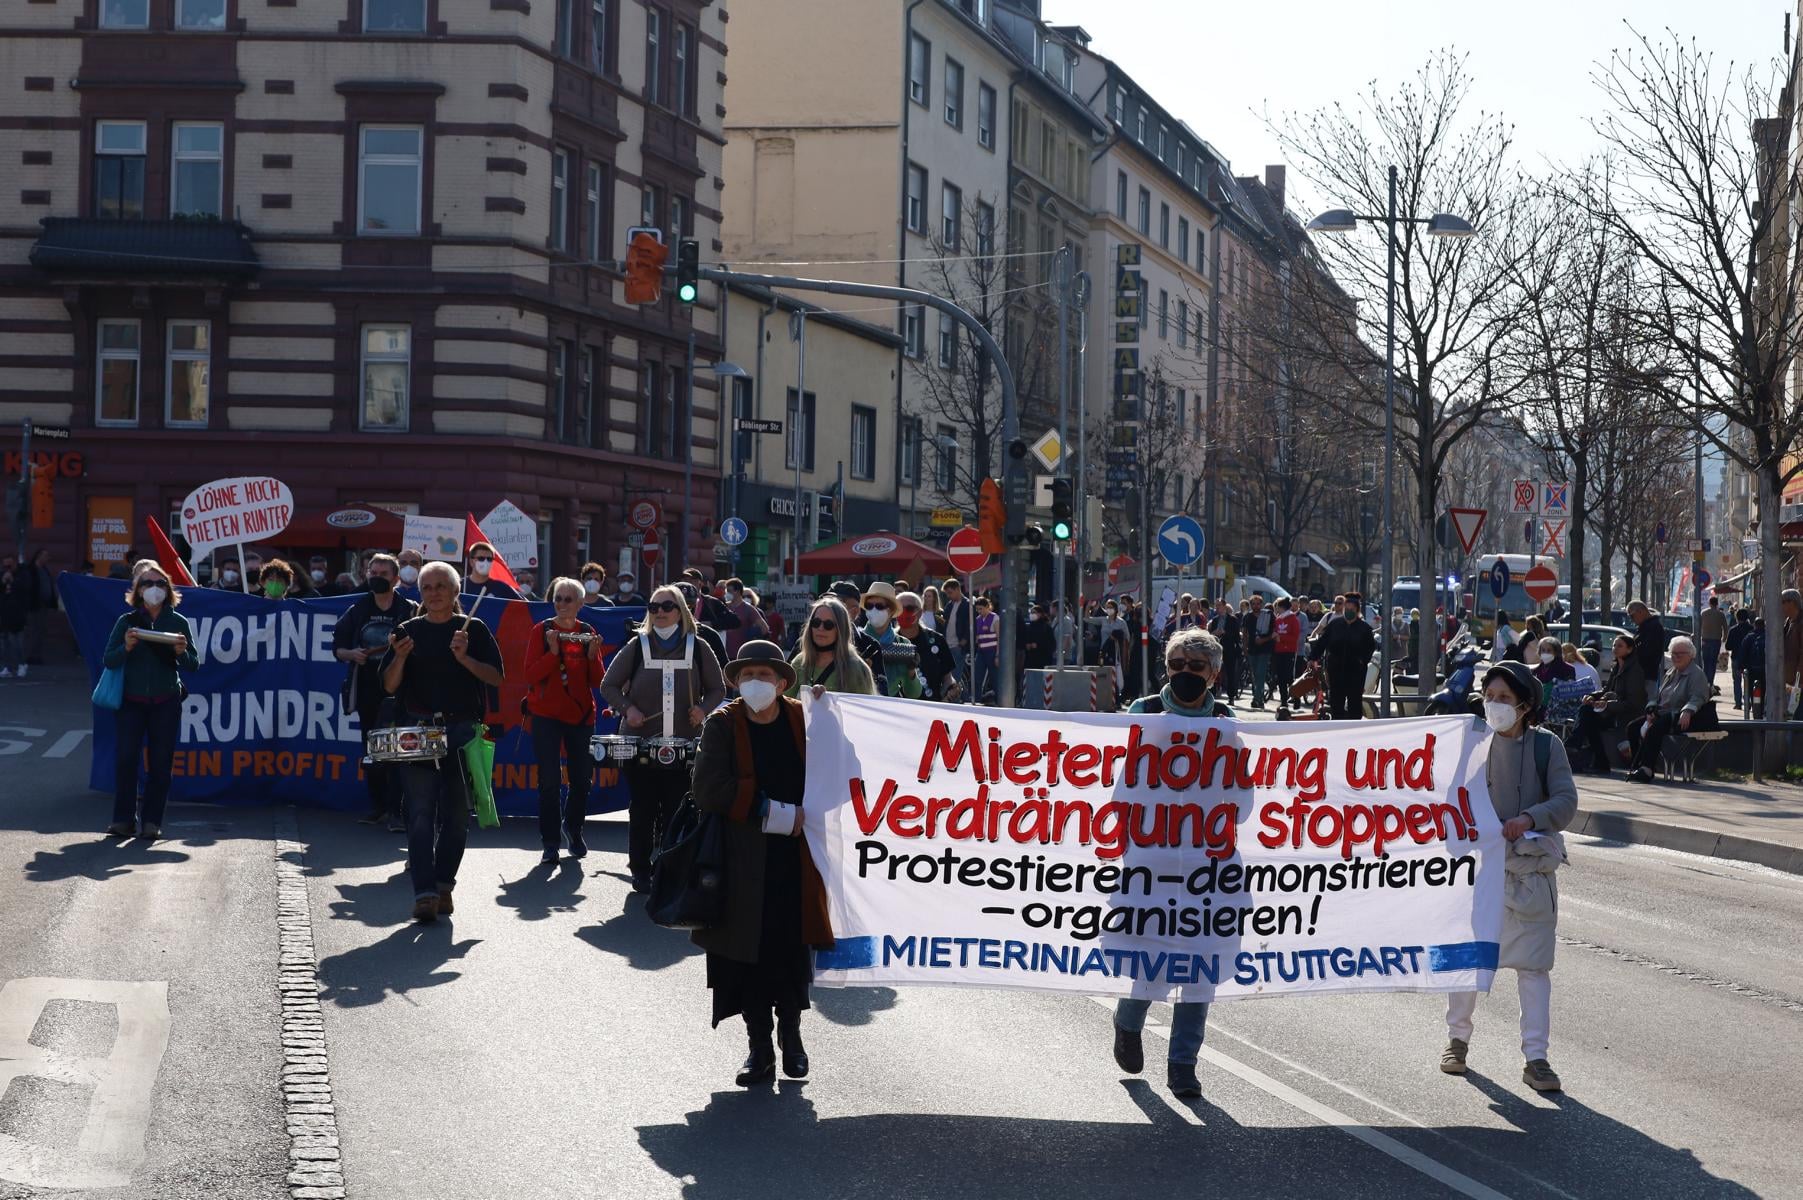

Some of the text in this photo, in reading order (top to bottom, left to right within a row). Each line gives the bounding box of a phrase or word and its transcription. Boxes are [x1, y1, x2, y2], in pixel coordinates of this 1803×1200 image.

[34, 427, 69, 439] Marienplatz
[740, 420, 781, 431] Böblinger Str.
[196, 479, 280, 513] LÖHNE HOCH
[92, 524, 107, 533] AUF
[187, 504, 289, 544] MIETEN RUNTER
[92, 543, 130, 553] WHOPPER
[232, 750, 346, 780] PROFIT
[917, 718, 1436, 801] Mieterhöhung und
[849, 776, 1479, 860] Verdrängung stoppen!
[882, 934, 1425, 985] MIETERINIATIVEN STUTTGART
